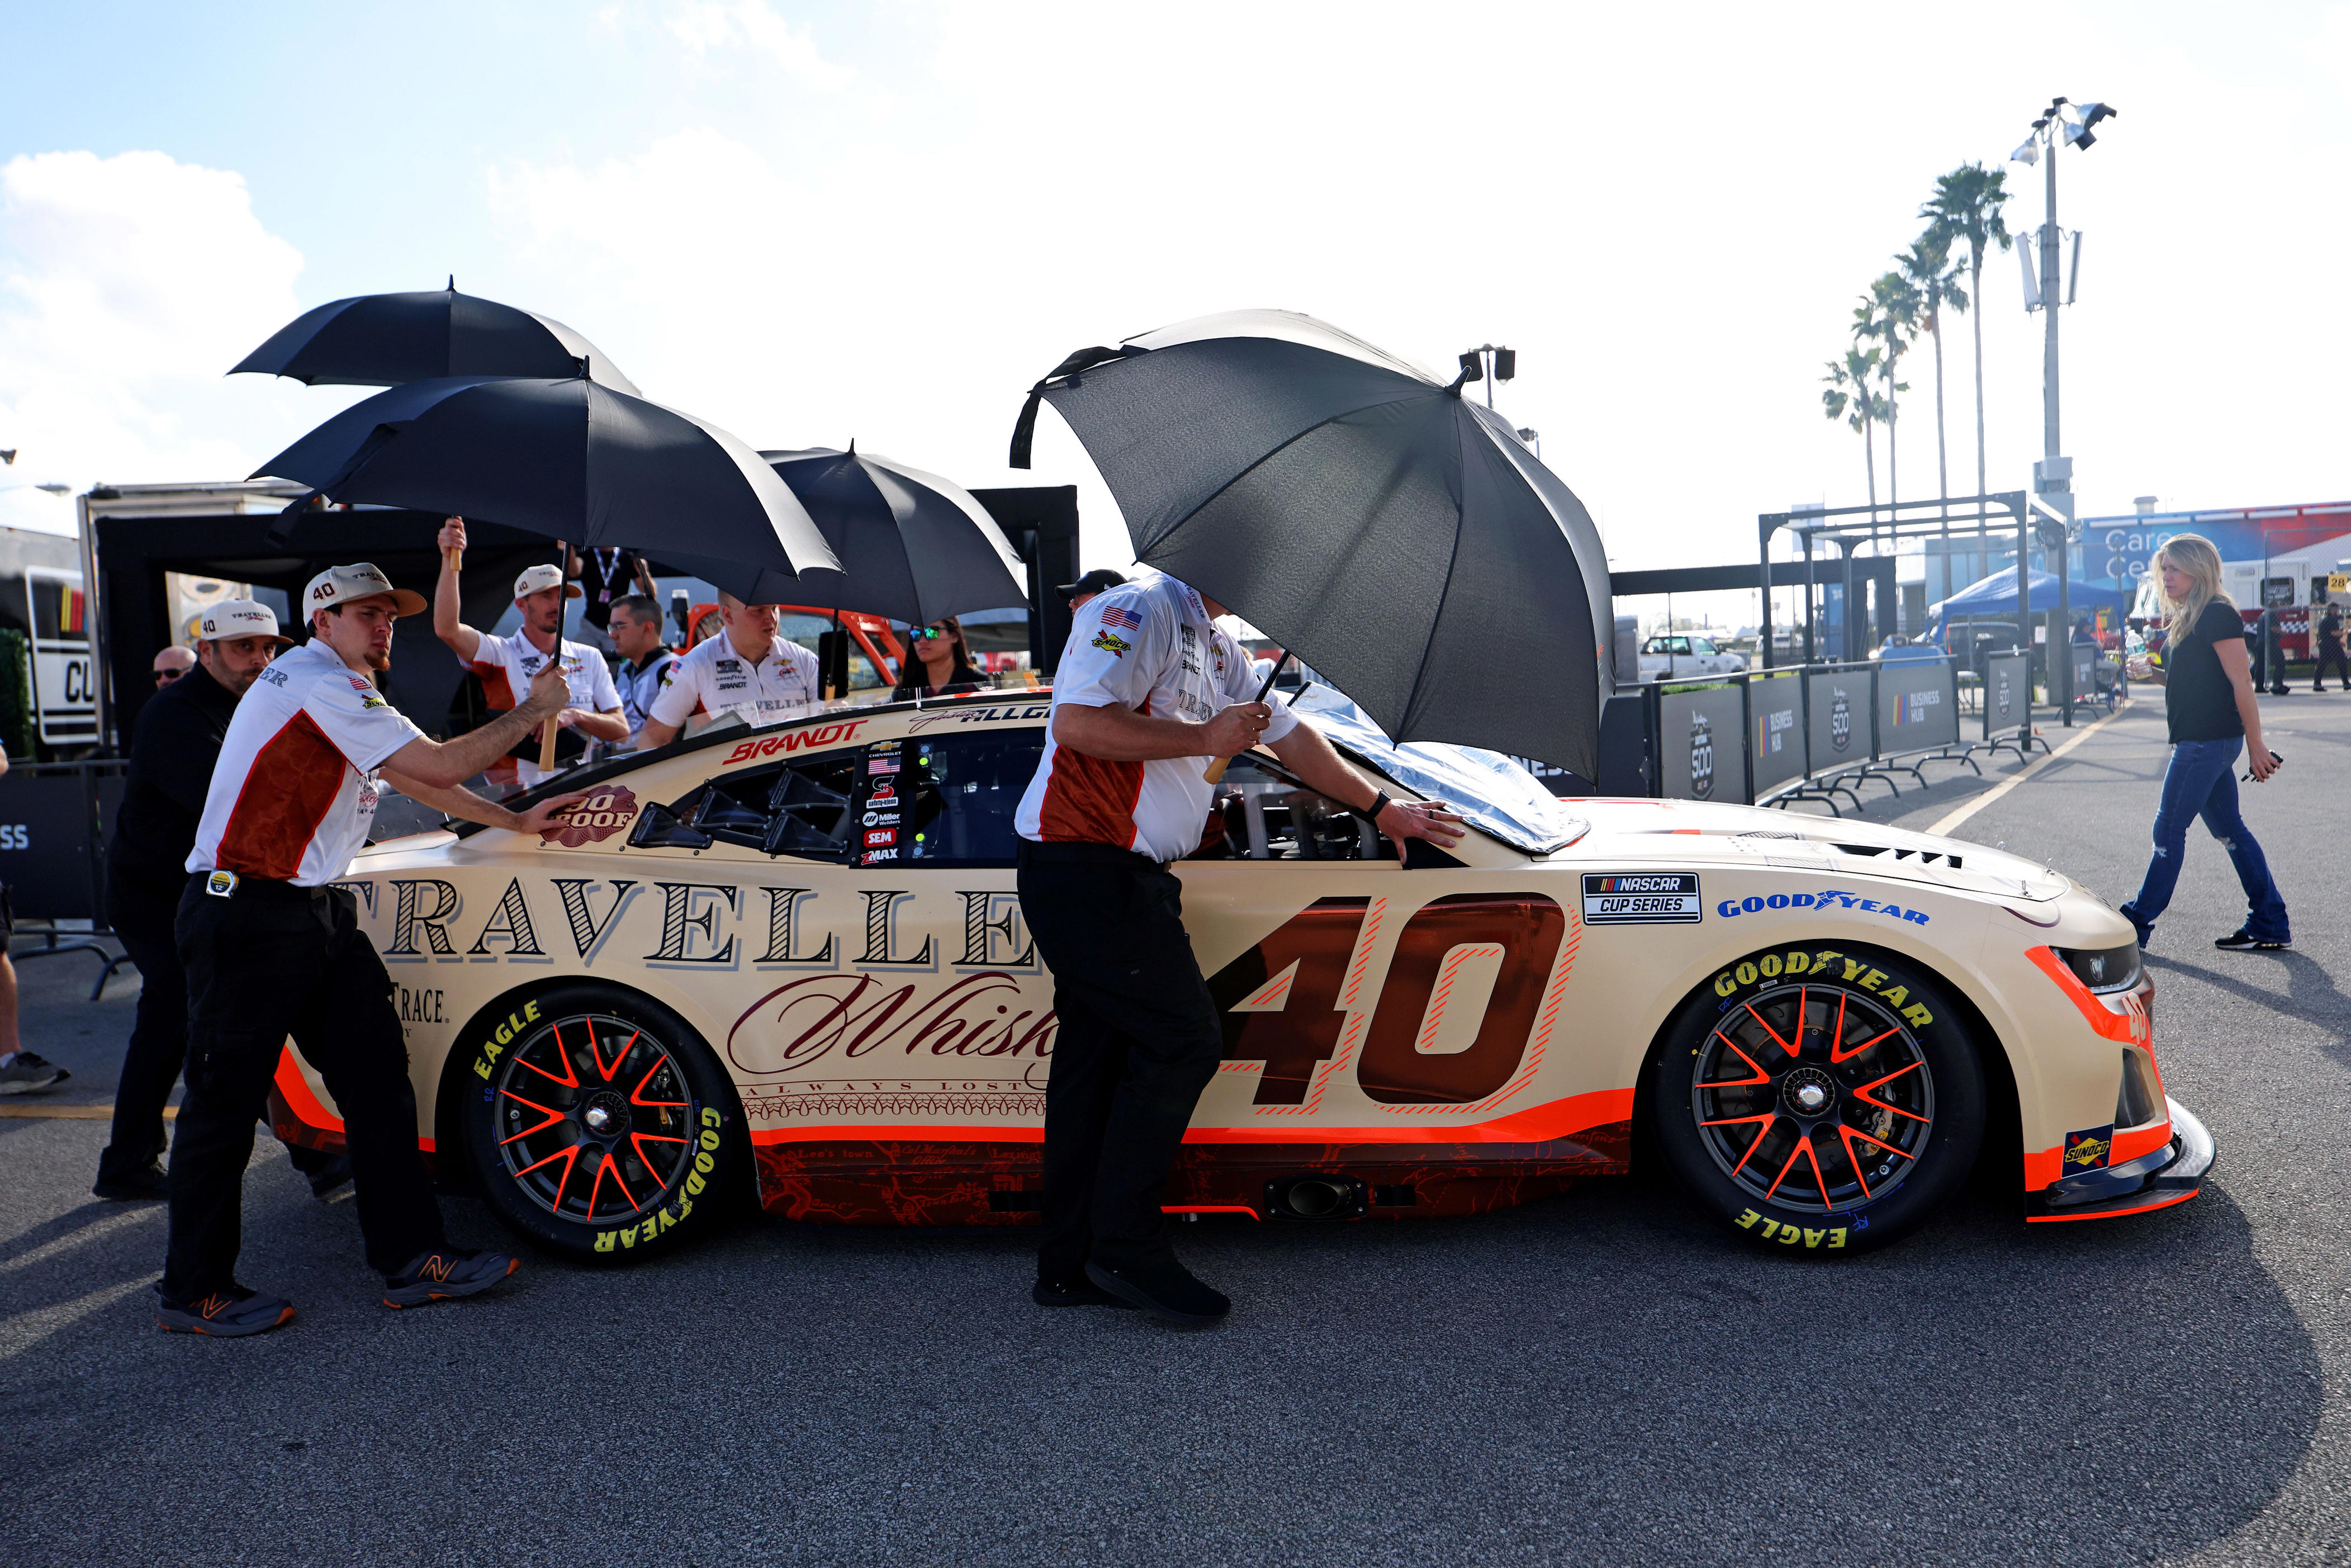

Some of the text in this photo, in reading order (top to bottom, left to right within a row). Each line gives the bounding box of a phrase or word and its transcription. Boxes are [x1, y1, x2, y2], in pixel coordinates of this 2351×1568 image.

[2106, 529, 2172, 552] Care
[518, 581, 529, 593] 40
[2331, 577, 2345, 587] 28
[313, 582, 336, 600] 40
[203, 619, 216, 634] 40
[1094, 639, 1129, 650] SNOCO
[1910, 690, 1940, 707] BUSINESS
[1999, 689, 2009, 707] 500
[1770, 709, 1793, 732] BUSINESS
[1832, 712, 1849, 735] 500
[1911, 708, 1925, 723] HUB
[722, 719, 868, 765] BRANDT
[1771, 732, 1782, 753] HUB
[1691, 745, 1712, 780] 500
[868, 798, 897, 807] safety-kleen
[551, 812, 633, 827] ROOF
[879, 813, 900, 822] Miller
[868, 831, 892, 844] SEM
[1619, 877, 1681, 892] NASCAR
[1600, 897, 1684, 913] CUP SERIES
[1206, 891, 1565, 1105] 40
[473, 999, 542, 1081] EAGLE
[746, 1082, 1021, 1096] ALWAYS LOST
[842, 1149, 874, 1158] town
[2066, 1141, 2109, 1162] SUNOCO
[1733, 1207, 1847, 1248] EAGLE
